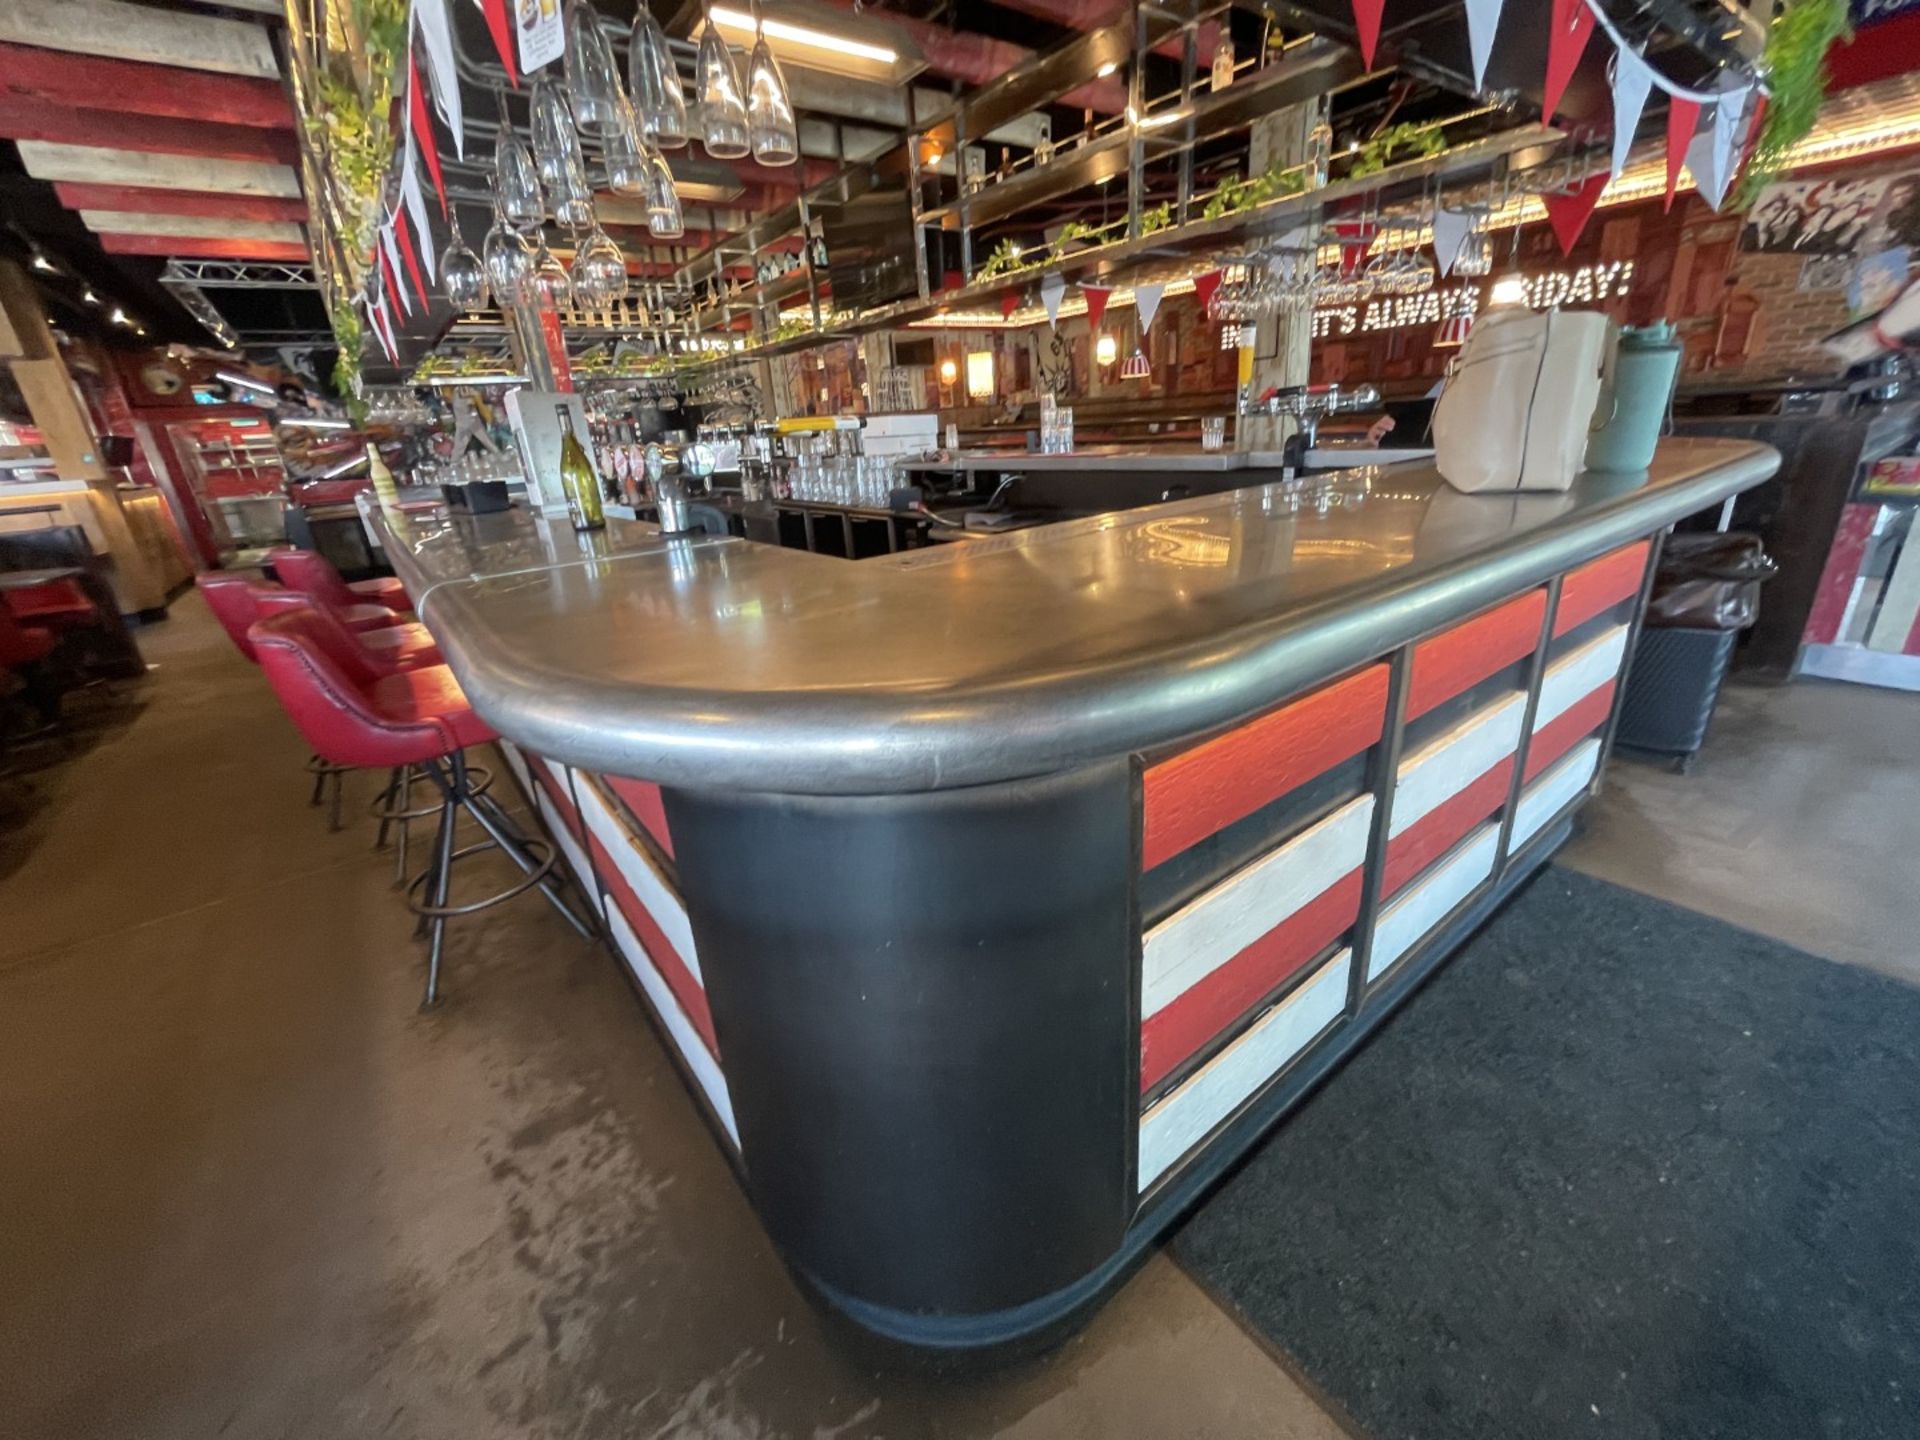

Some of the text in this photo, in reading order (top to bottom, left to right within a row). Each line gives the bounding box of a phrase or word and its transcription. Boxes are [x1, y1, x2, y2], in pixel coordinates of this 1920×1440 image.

[1312, 306, 1357, 338] IT'S
[1361, 286, 1480, 332] ALWAYS
[1520, 260, 1634, 309] RIDAY!
